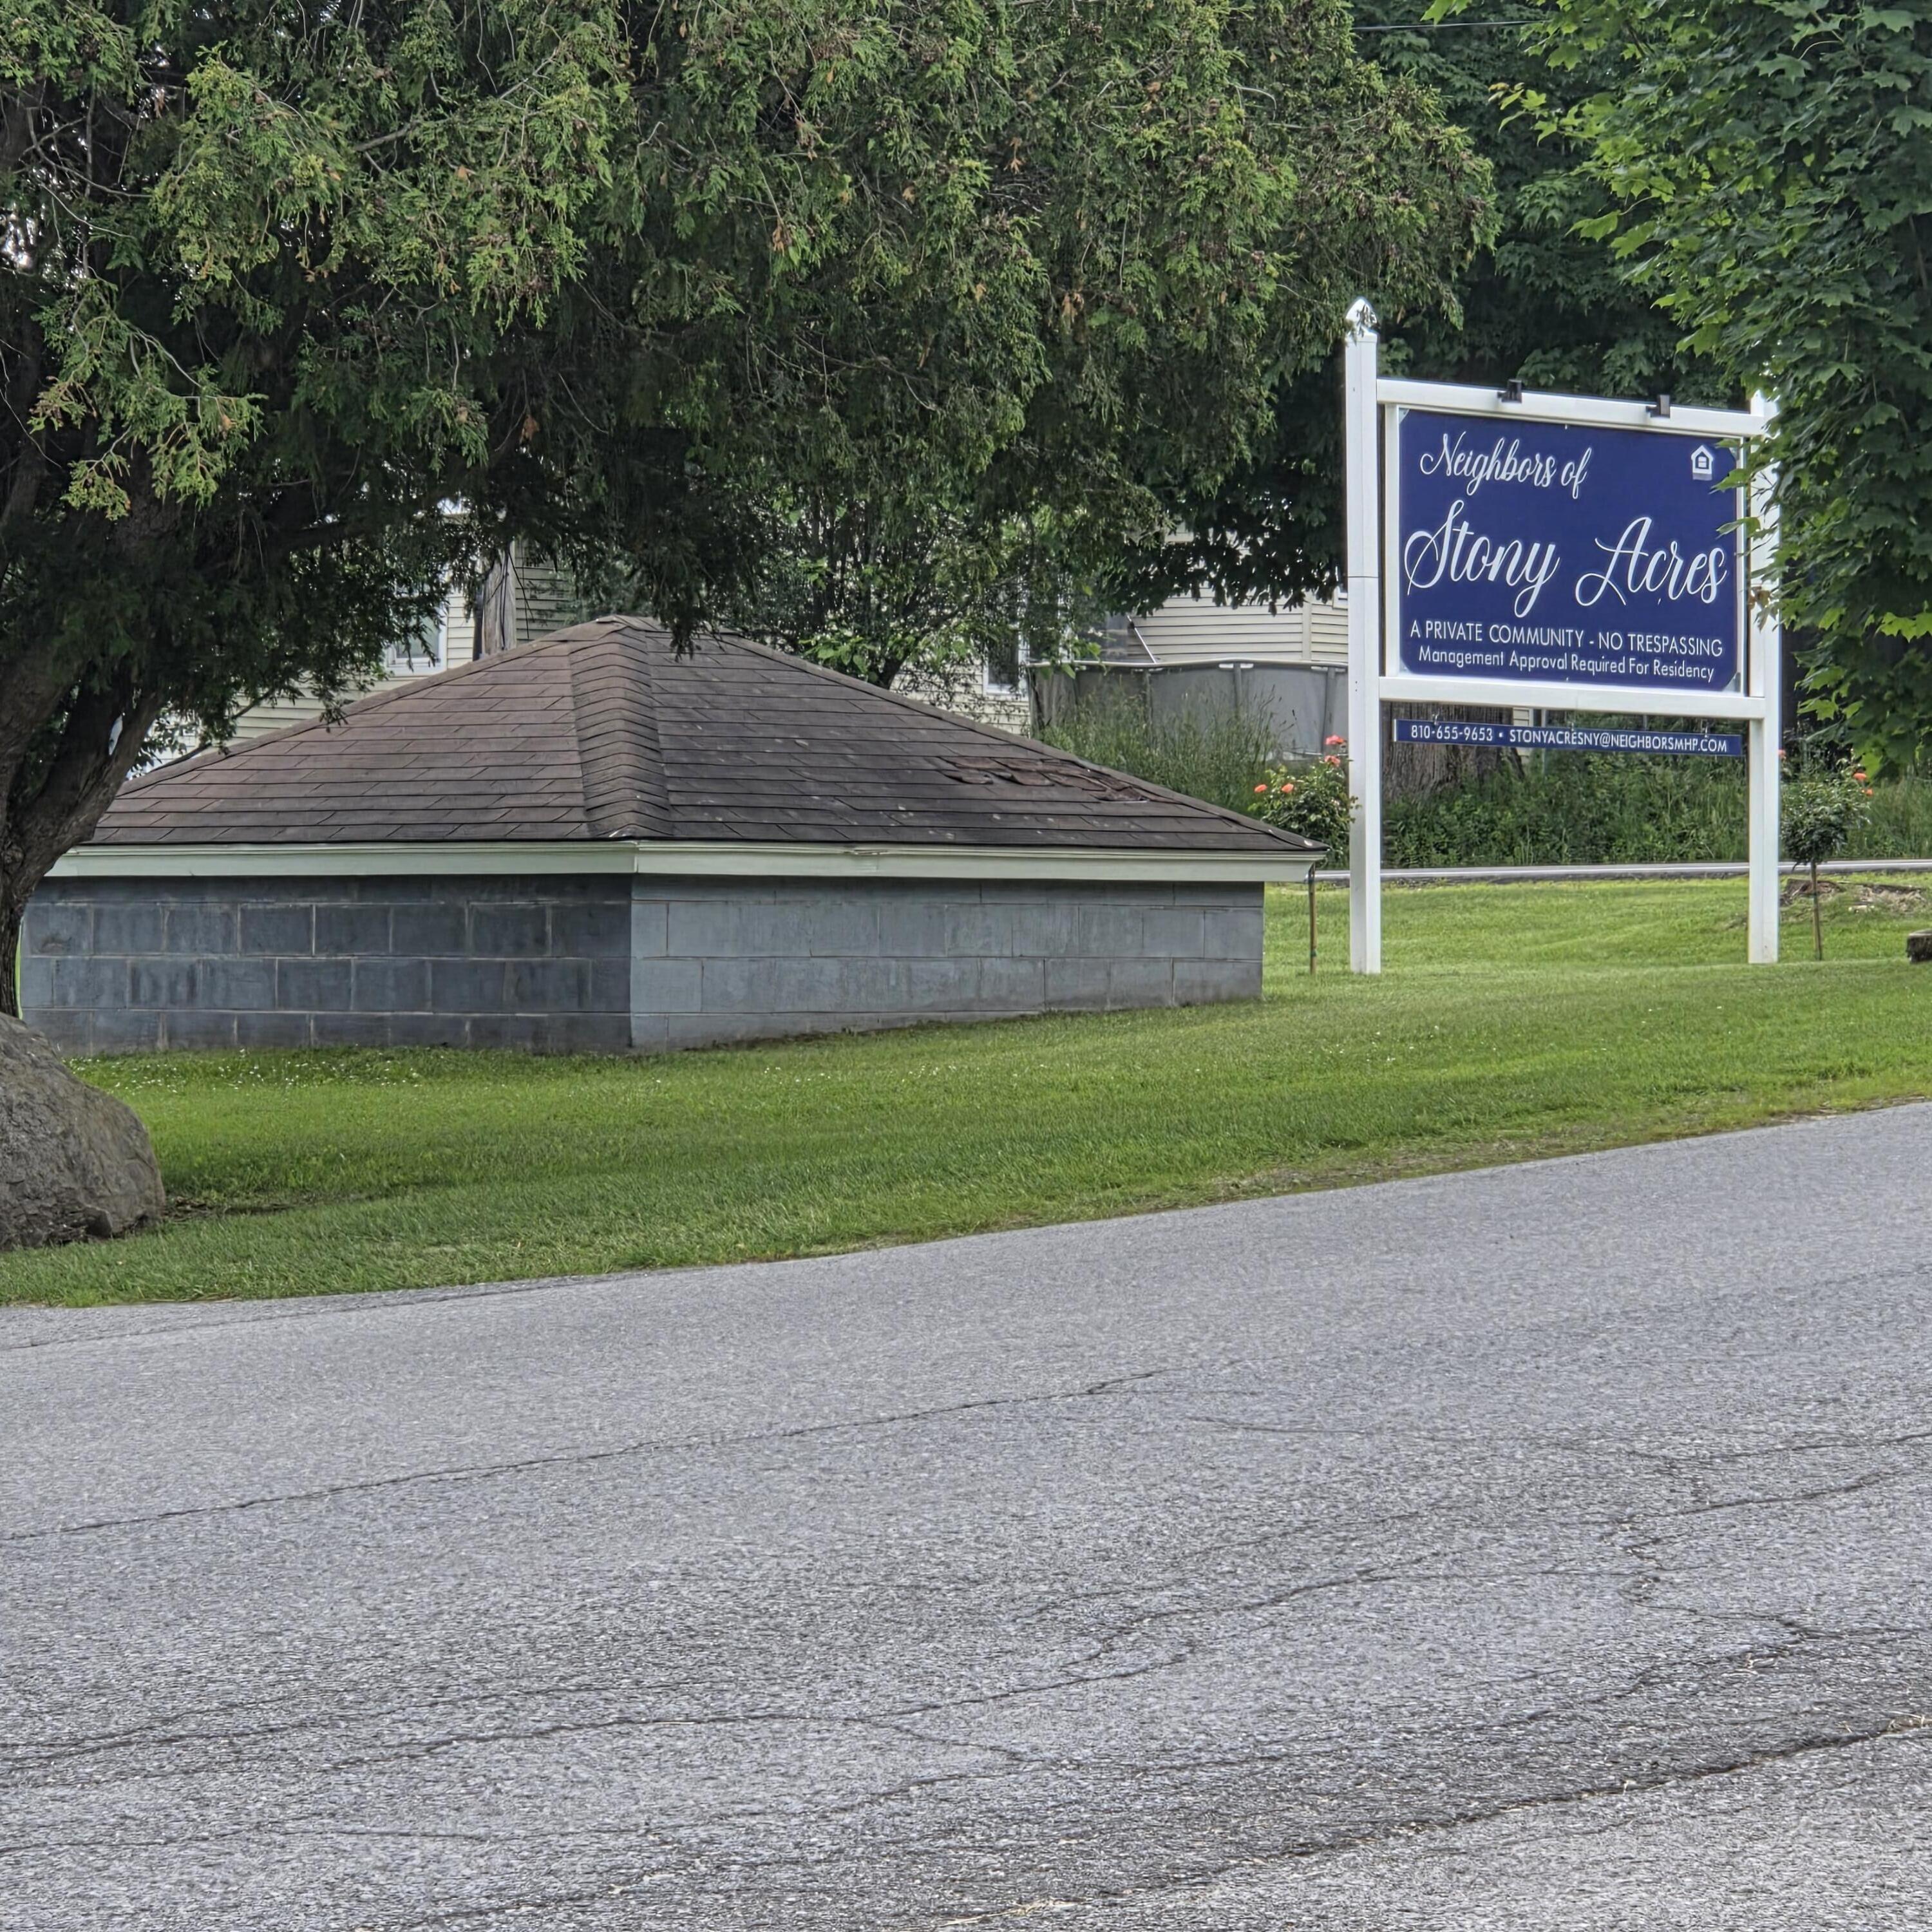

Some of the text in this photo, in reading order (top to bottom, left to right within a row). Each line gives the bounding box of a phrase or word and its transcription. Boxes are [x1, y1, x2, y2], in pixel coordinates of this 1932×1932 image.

[1420, 431, 1593, 499] Neighbors of
[1404, 500, 1727, 618] Stony Acres
[1410, 620, 1421, 638] A
[1426, 620, 1482, 641] PRIVATE
[1489, 624, 1584, 648] COMMUNITY
[1599, 632, 1623, 650] NO
[1627, 634, 1723, 657] TRESPASSING
[1419, 645, 1714, 683] Management Approval Required For Residency
[1411, 724, 1493, 741] 810-655-9653
[1510, 729, 1727, 753] STONYACRESNY@NEIGHBORSMHP.COM
